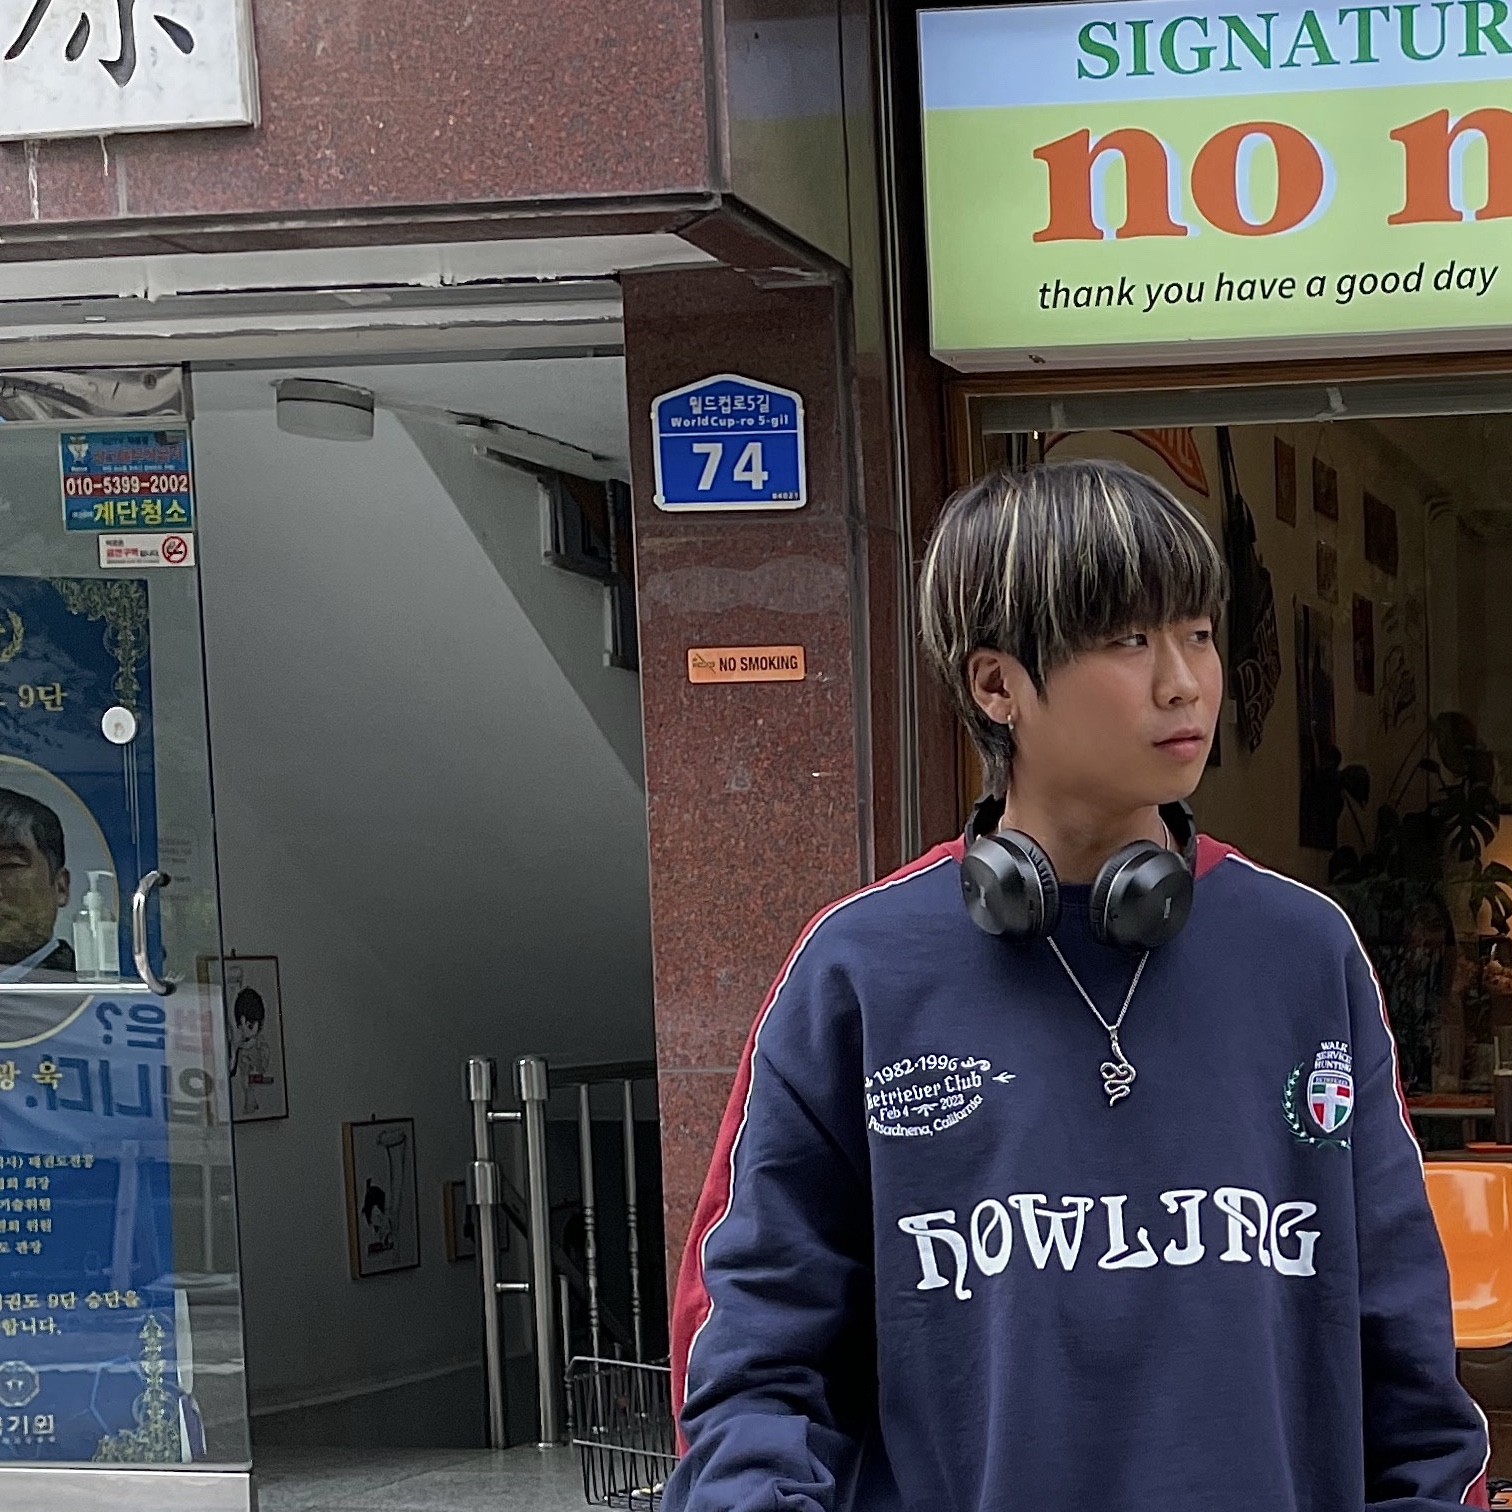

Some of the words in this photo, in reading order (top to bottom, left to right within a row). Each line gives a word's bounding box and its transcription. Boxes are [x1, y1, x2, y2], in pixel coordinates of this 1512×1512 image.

[1031, 121, 1332, 243] no
[1037, 276, 1135, 311] thank
[1142, 275, 1205, 313] you
[1214, 267, 1297, 304] have
[1305, 274, 1326, 299] a
[1334, 261, 1424, 305] good
[1432, 257, 1499, 298] day
[689, 394, 770, 415] 월드컵로5길
[758, 414, 789, 428] 5-gil
[692, 442, 769, 491] 74
[66, 474, 188, 495] 010-5399-2002
[93, 499, 187, 526] 계단청소
[719, 657, 736, 672] NO
[740, 655, 798, 671] SMOKING
[17, 683, 67, 712] 9단
[1320, 1041, 1349, 1052] WALK
[1314, 1060, 1352, 1073] HUNTING
[1315, 1051, 1353, 1064] SERVICE
[944, 1071, 983, 1093] Club
[880, 1106, 901, 1121] Feb
[940, 1093, 965, 1110] 2023
